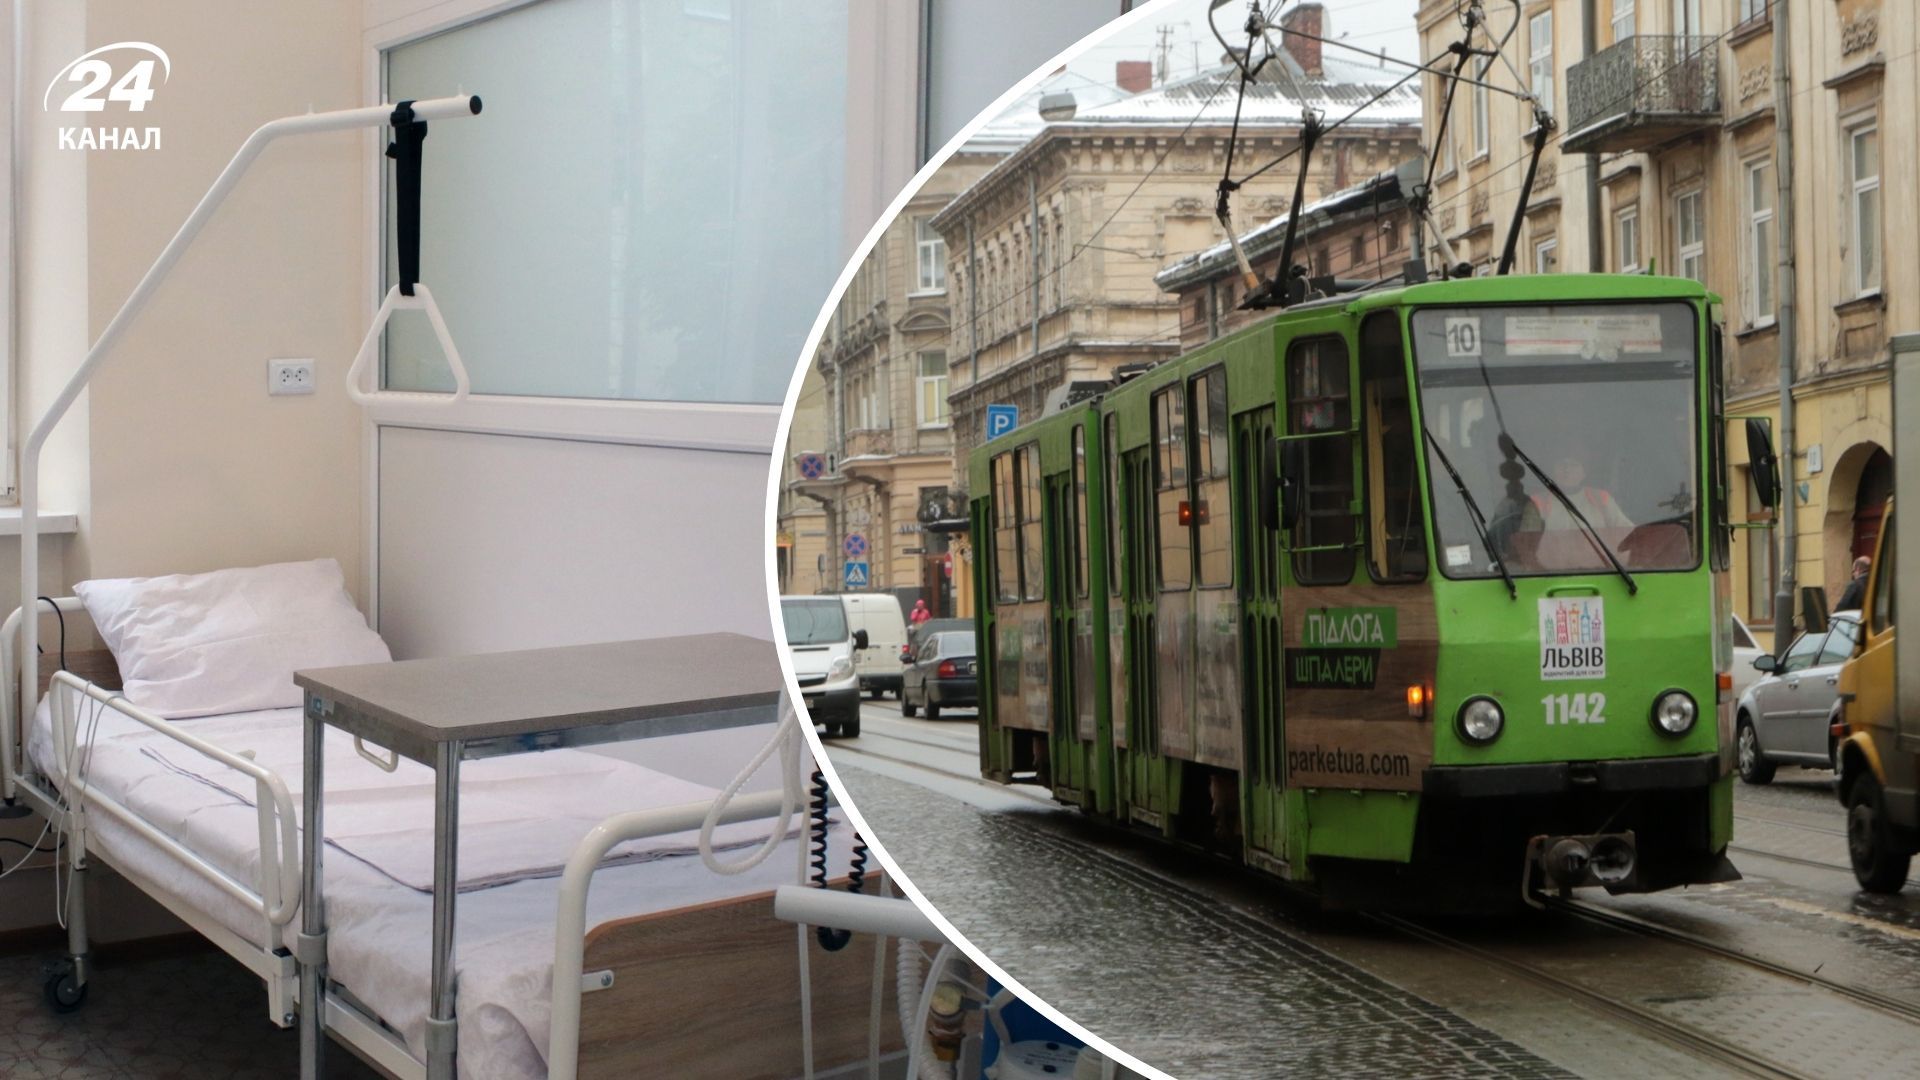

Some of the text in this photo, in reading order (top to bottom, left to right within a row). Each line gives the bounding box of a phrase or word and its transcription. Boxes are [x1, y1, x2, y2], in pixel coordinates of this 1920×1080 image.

[1448, 323, 1476, 353] 10
[995, 414, 1009, 434] P
[1309, 613, 1384, 646] ПІДЛОГА
[1295, 655, 1374, 685] ШПАЛЕРИ
[1542, 646, 1604, 669] ЛЬВІВ
[1541, 692, 1606, 725] 1142
[1288, 744, 1410, 778] parketua.com
